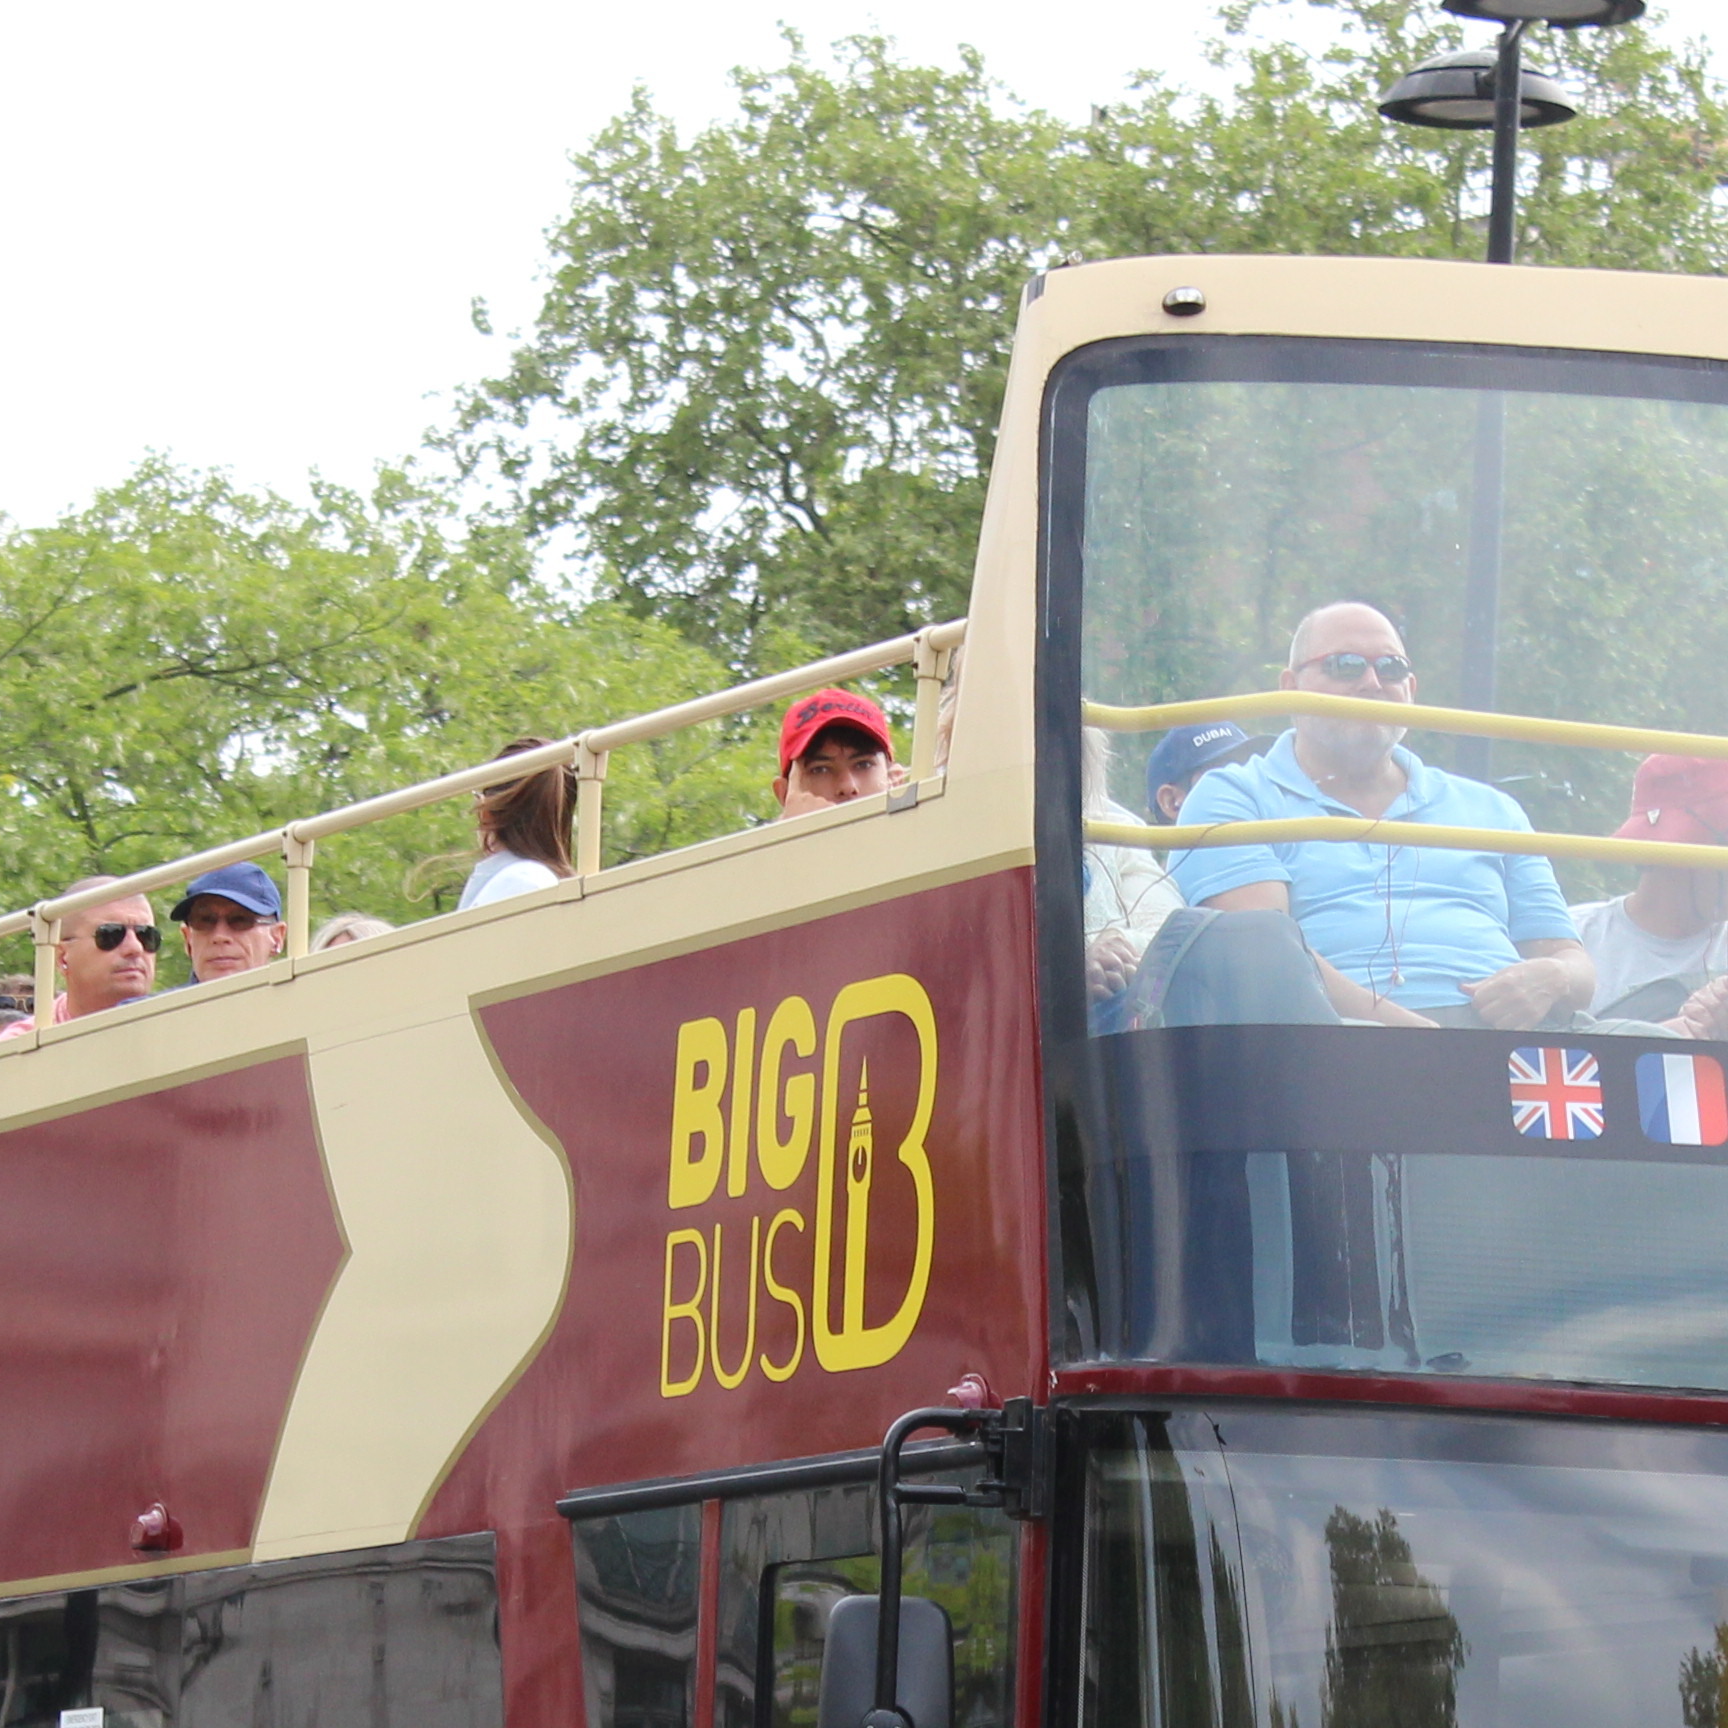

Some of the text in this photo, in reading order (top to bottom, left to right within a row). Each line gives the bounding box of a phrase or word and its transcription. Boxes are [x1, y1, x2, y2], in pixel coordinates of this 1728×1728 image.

[1192, 727, 1233, 747] DUBAI
[668, 996, 816, 1210] BIG
[660, 1208, 805, 1398] BUS
